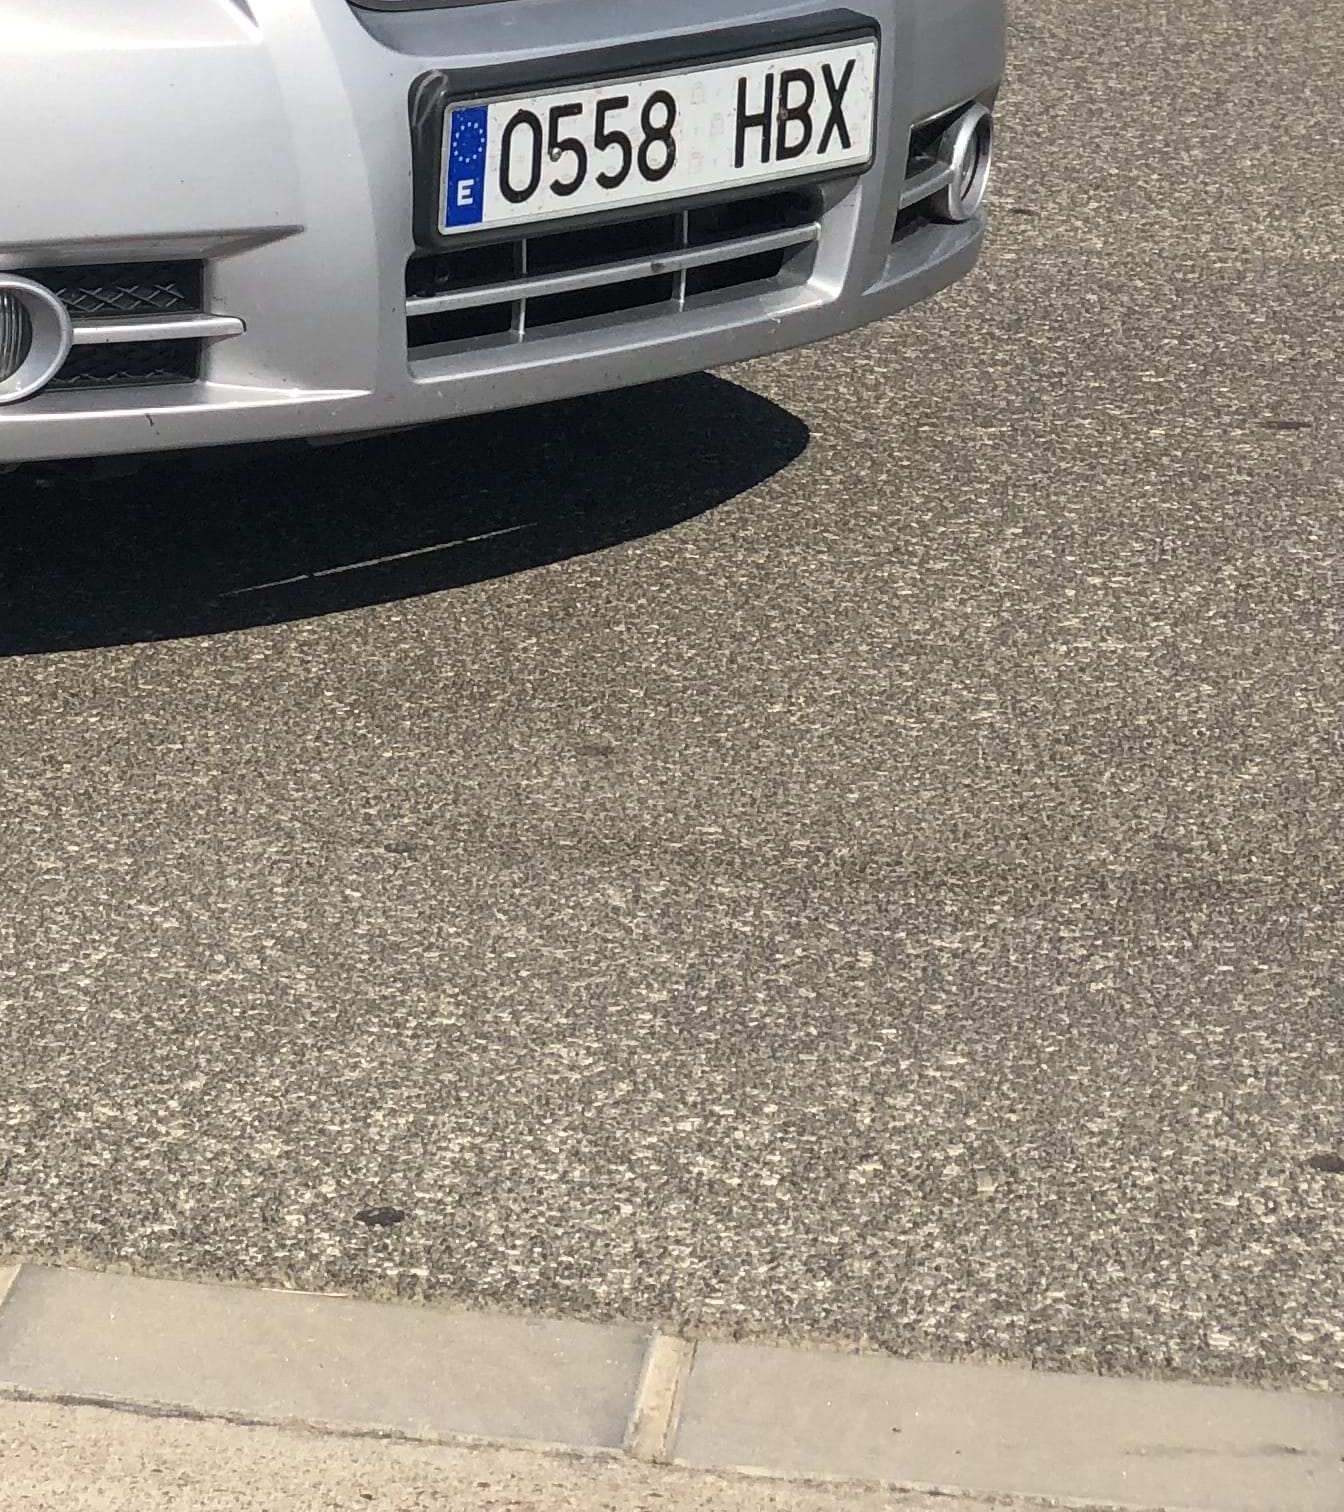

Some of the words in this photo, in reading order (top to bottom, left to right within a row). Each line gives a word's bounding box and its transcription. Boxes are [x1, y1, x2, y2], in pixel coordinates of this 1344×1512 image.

[499, 89, 678, 204] 0558
[734, 59, 856, 169] HBX
[457, 179, 474, 207] E
